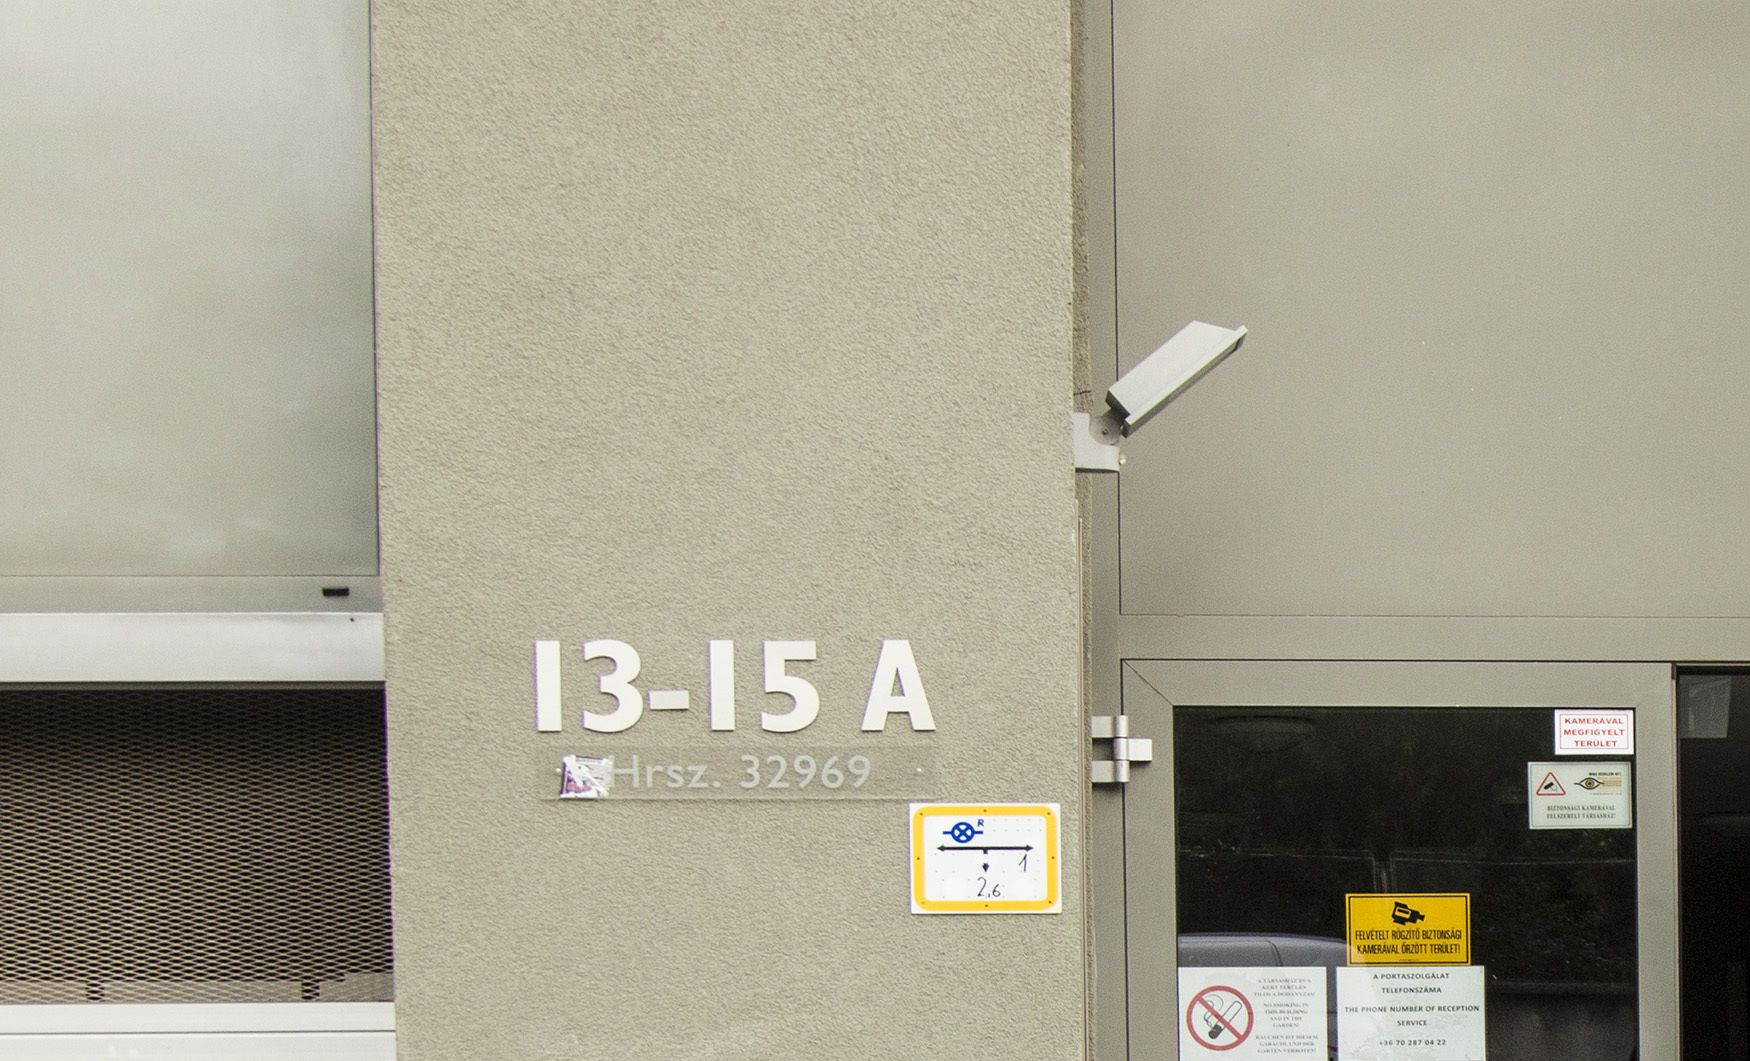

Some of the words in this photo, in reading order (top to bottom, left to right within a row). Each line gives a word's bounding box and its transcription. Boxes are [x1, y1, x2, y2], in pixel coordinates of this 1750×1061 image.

[535, 639, 820, 733] 13-15
[861, 639, 937, 733] A
[1564, 717, 1624, 725] KAMERÁVAL
[1574, 739, 1618, 747] TERÜLET
[609, 755, 721, 789] Hrsz.
[740, 754, 871, 789] 32969
[977, 819, 985, 827] R
[1018, 853, 1028, 873] 1
[1355, 929, 1389, 941] FELVÉTELT
[1422, 928, 1462, 940] BIZTONSÁGI
[1357, 942, 1399, 954] KAMERÁVAL
[1430, 942, 1461, 954] TERÜLET!
